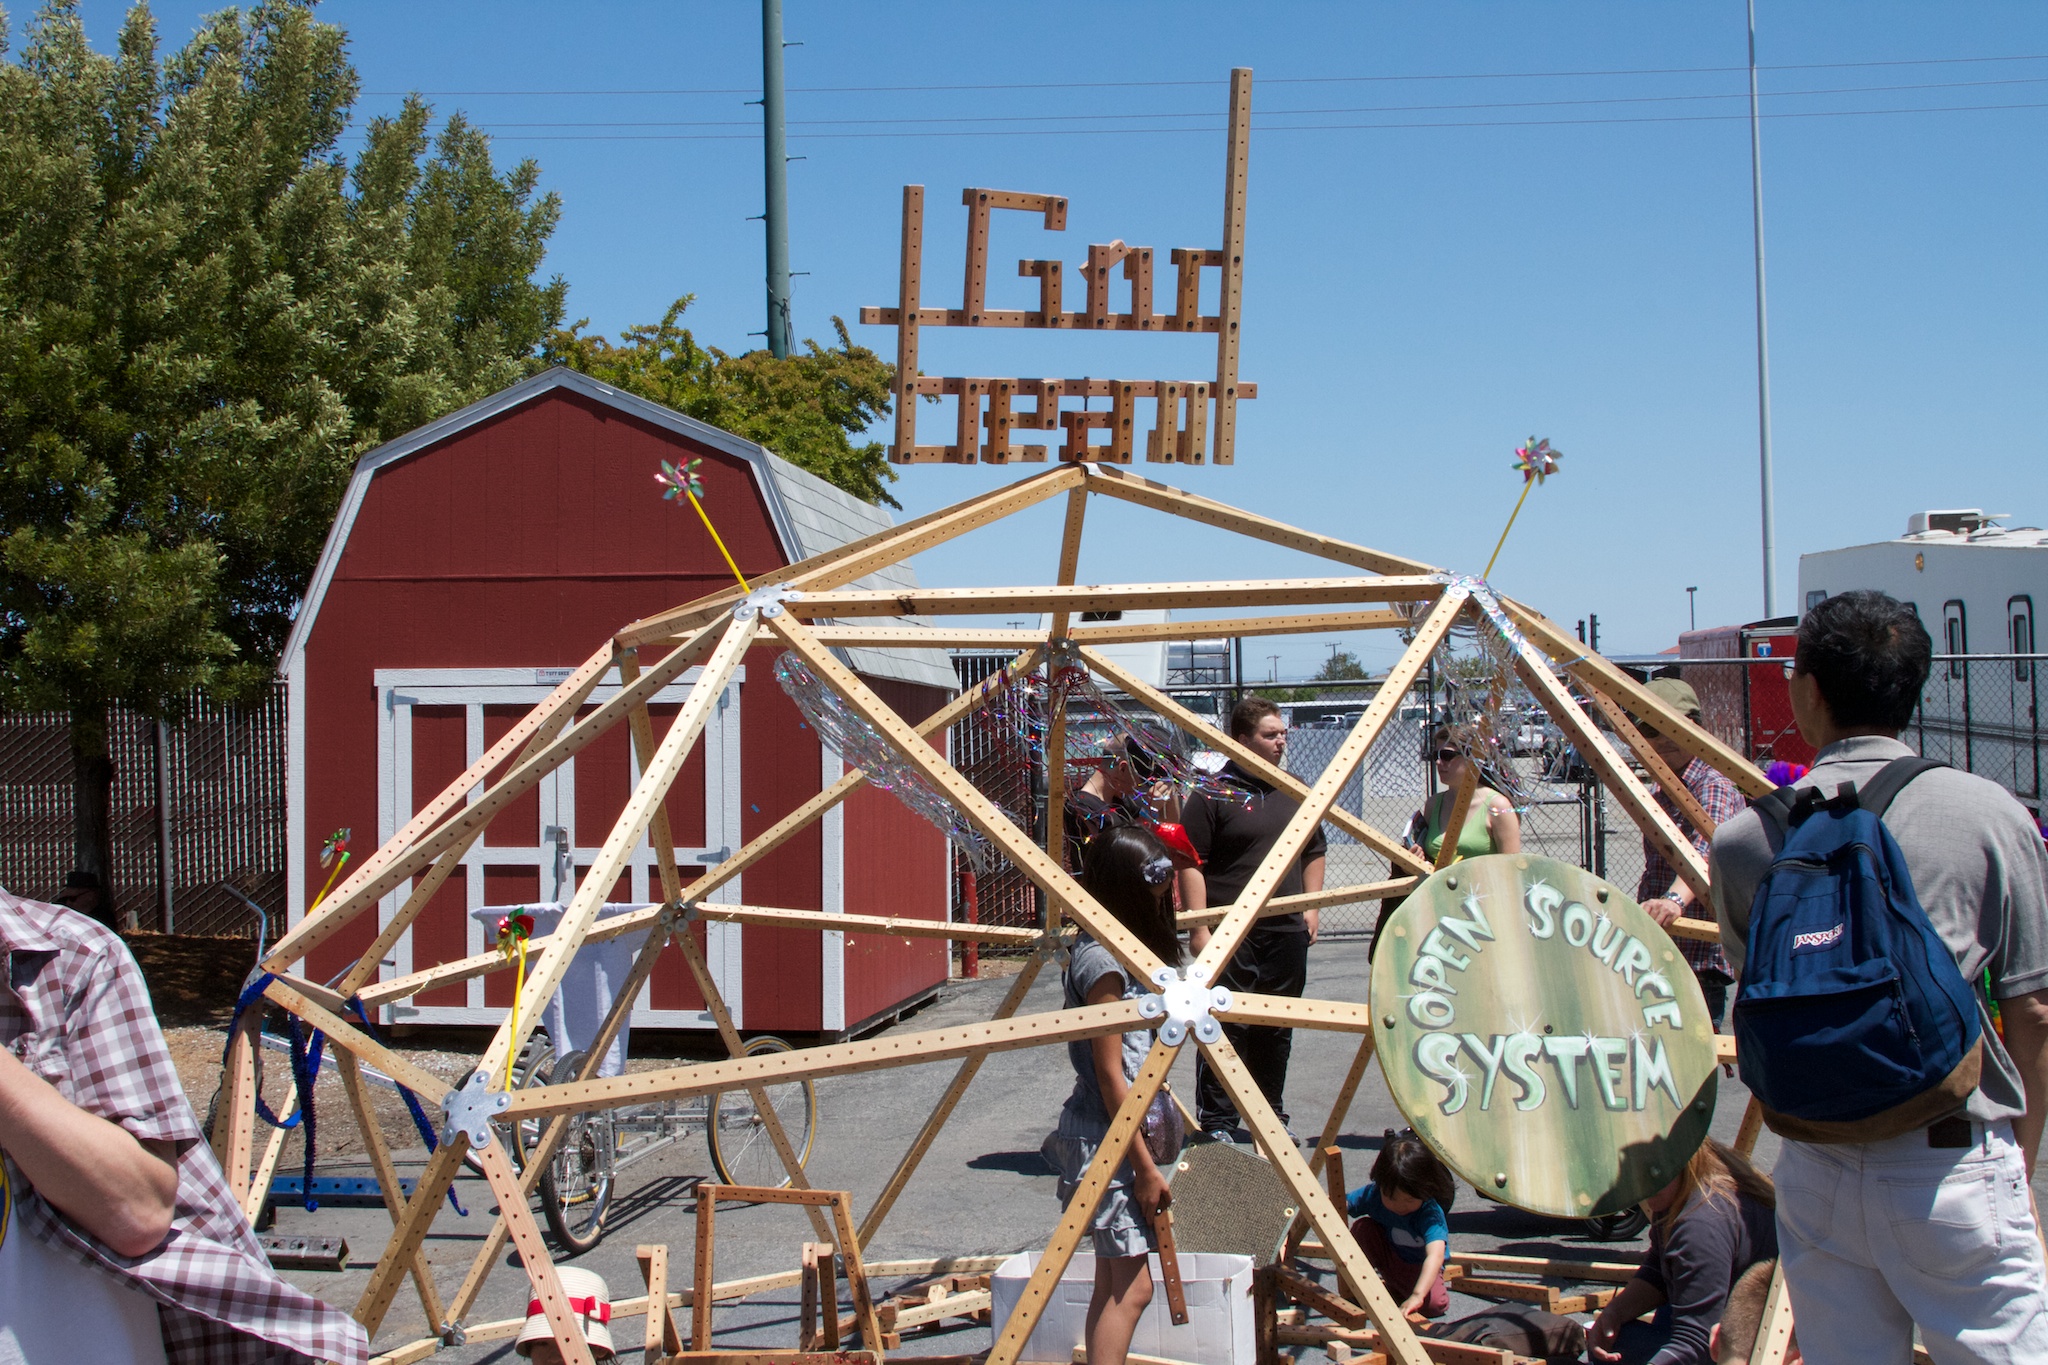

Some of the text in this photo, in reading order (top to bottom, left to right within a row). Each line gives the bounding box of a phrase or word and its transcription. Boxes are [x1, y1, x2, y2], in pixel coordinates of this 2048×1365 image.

[1406, 882, 1684, 1030] OPEN SOURCE
[1412, 1031, 1684, 1116] SYSTEM
